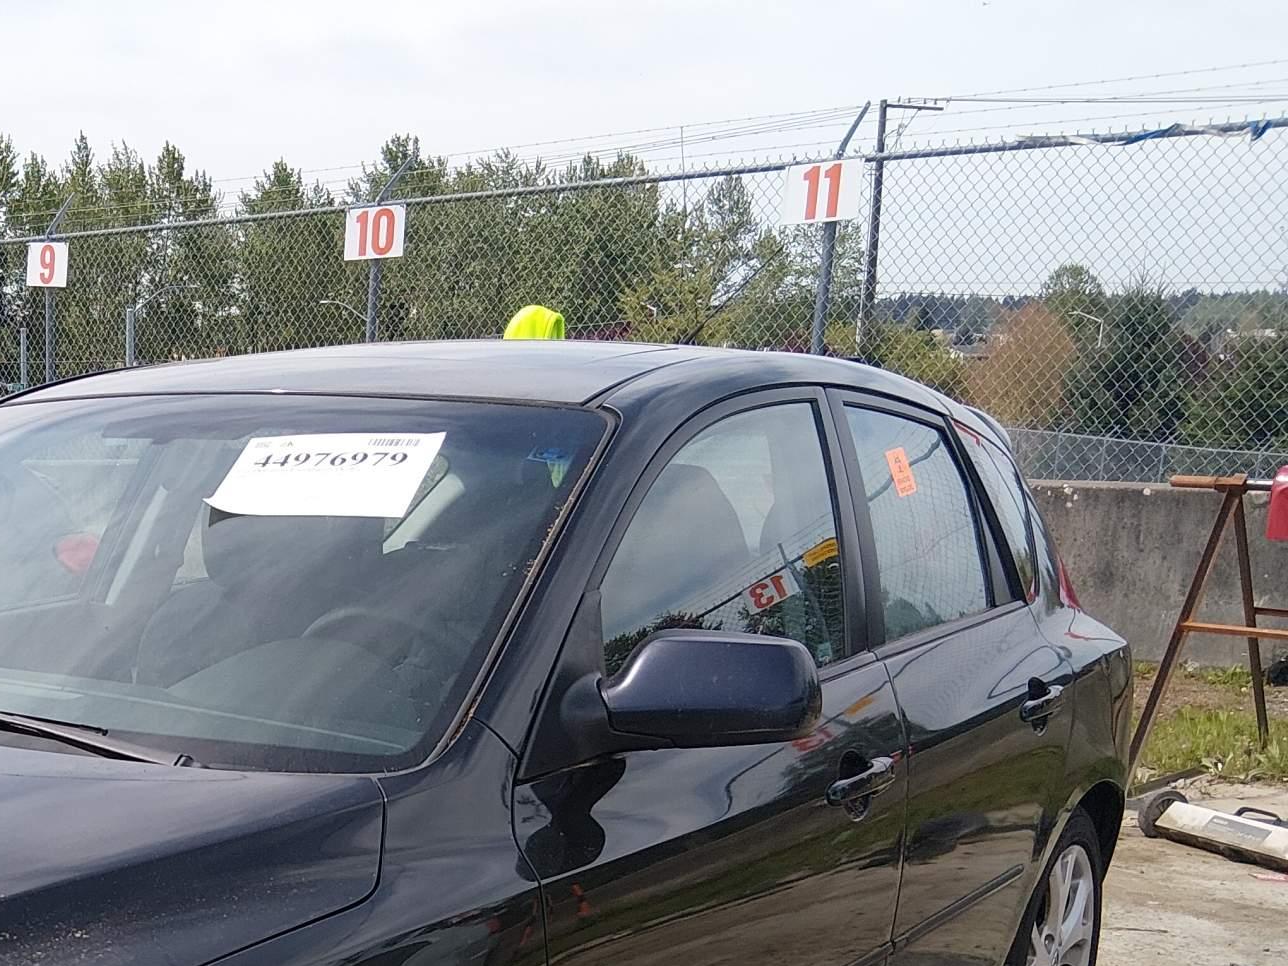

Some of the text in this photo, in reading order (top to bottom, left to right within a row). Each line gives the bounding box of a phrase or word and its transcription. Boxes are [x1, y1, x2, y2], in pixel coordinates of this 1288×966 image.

[803, 163, 843, 220] 11
[355, 207, 396, 257] 10
[39, 244, 56, 285] 9
[253, 451, 409, 468] 44976979
